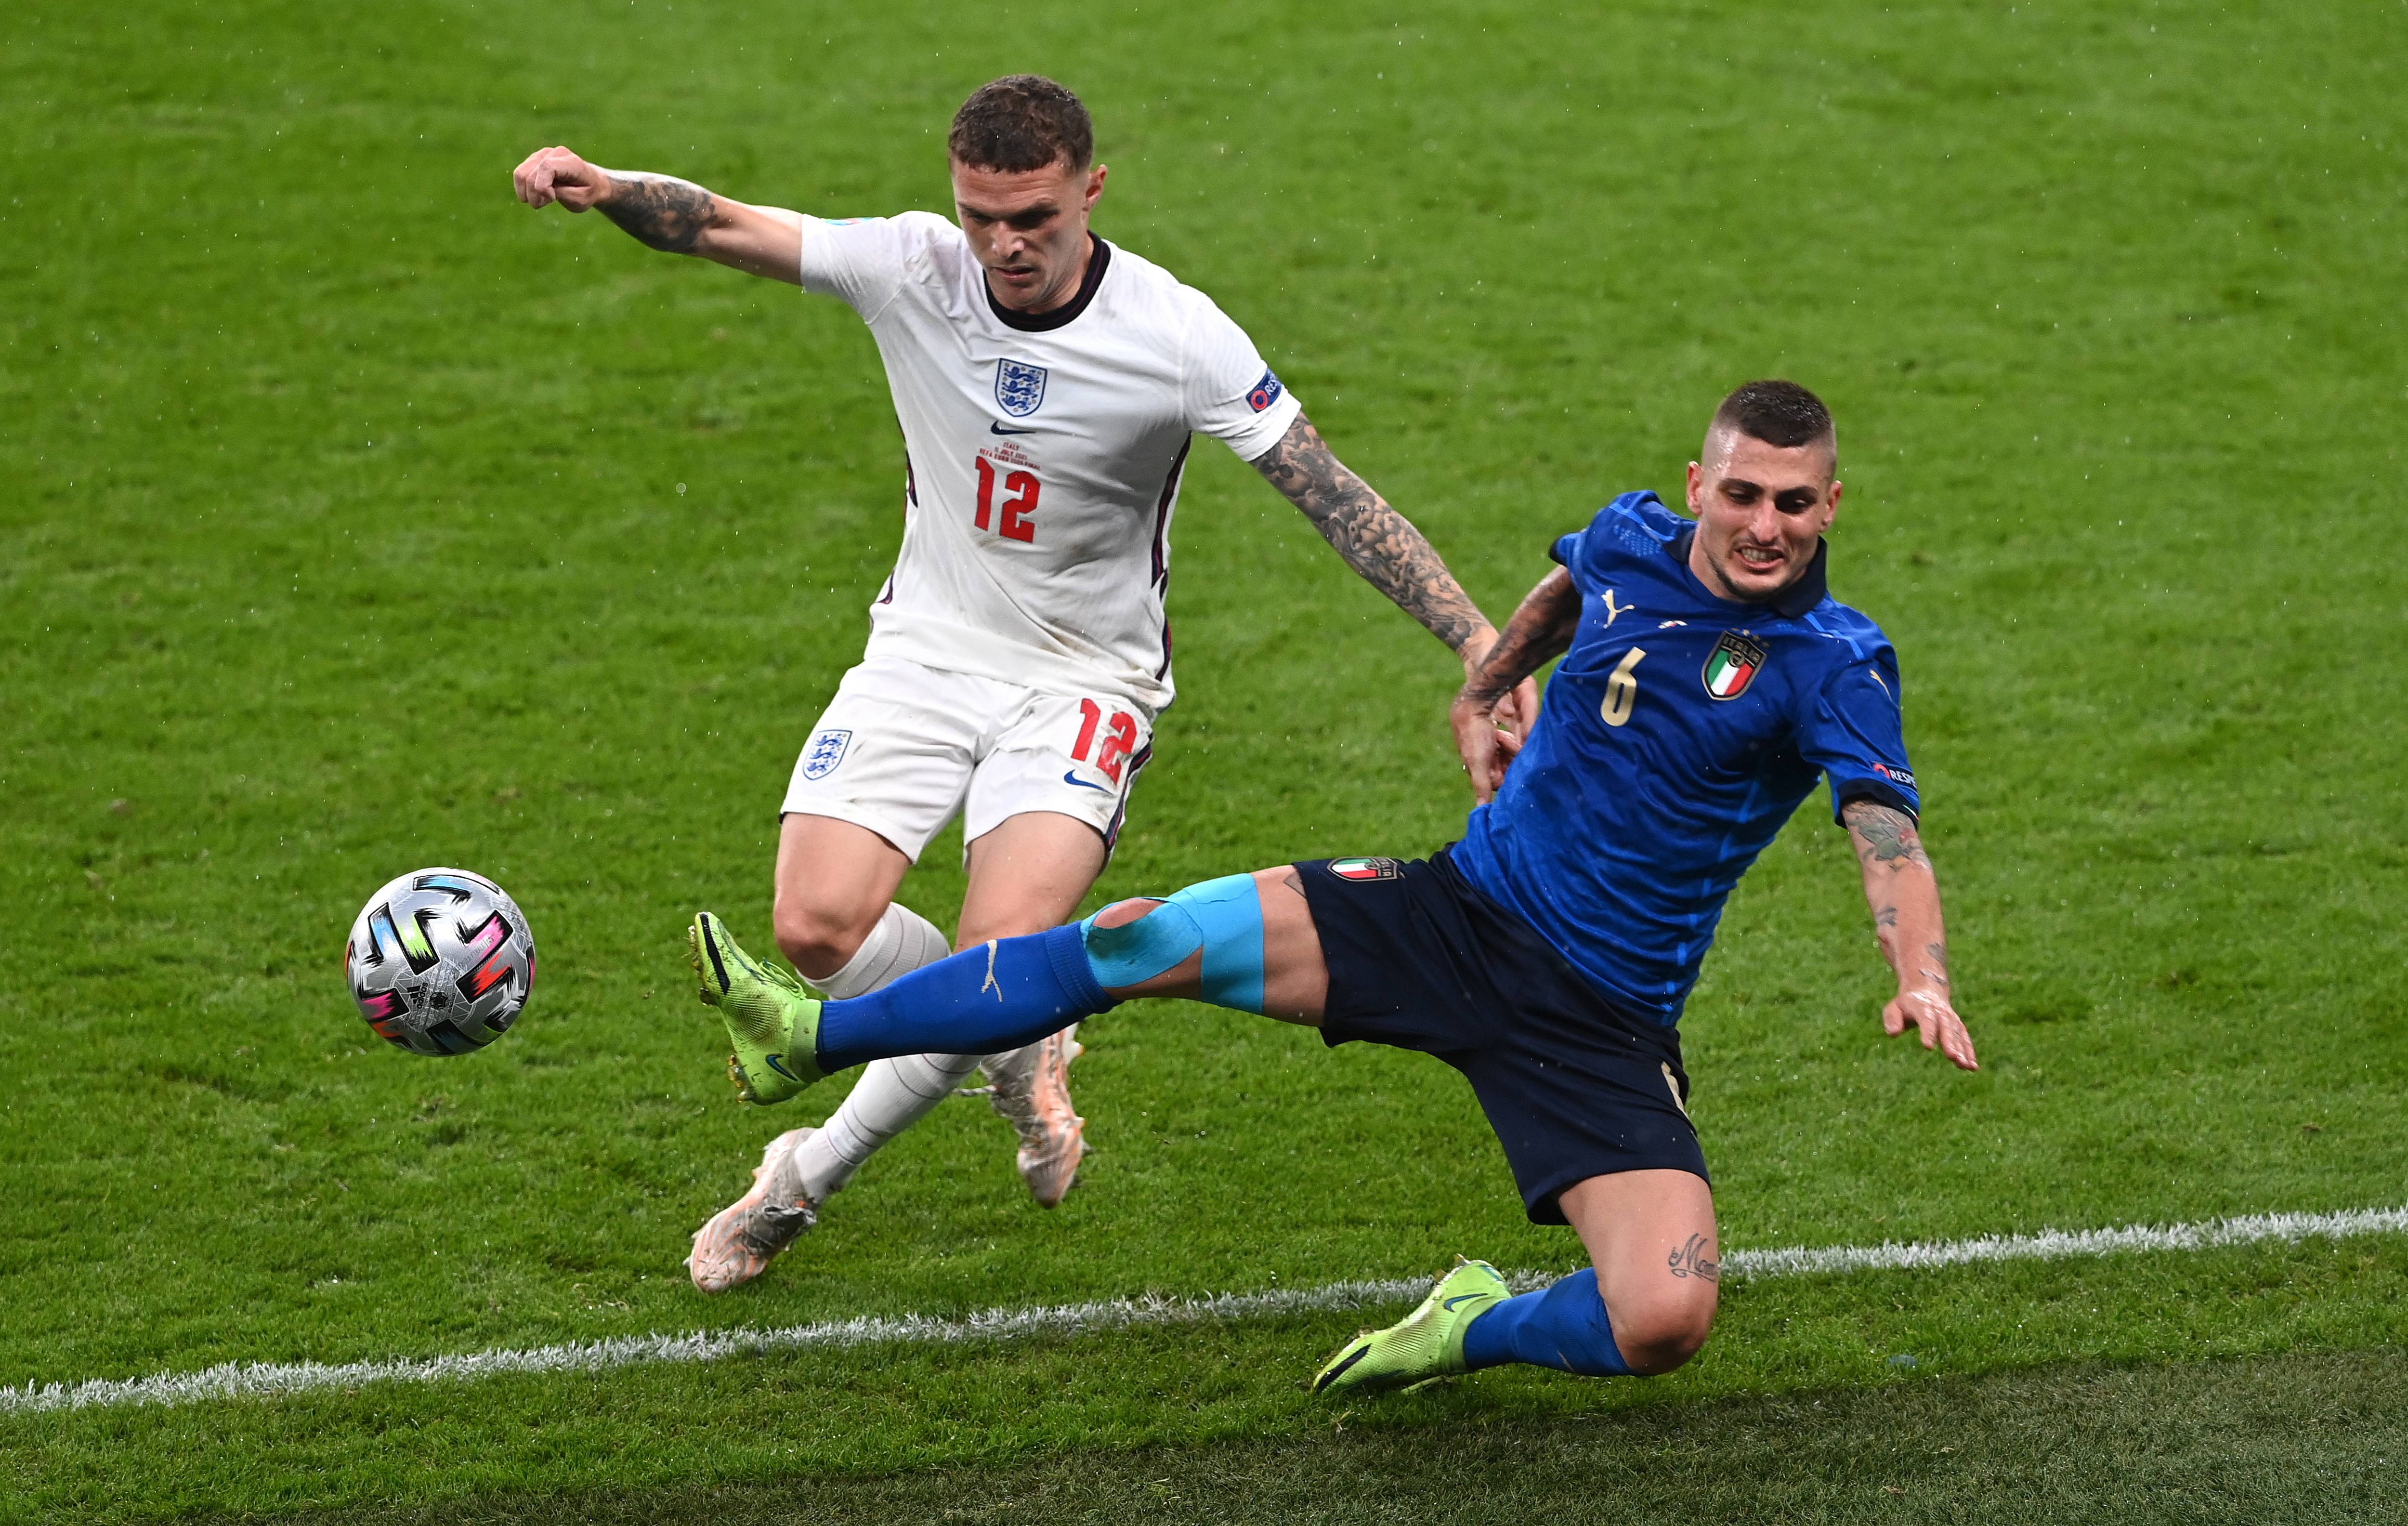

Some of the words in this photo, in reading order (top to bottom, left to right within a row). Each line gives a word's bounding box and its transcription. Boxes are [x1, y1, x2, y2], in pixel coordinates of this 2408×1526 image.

[1003, 442, 1019, 451] ITALY
[974, 456, 1041, 543] 12
[1600, 646, 1647, 726] 6
[1071, 698, 1137, 785] 12
[417, 982, 428, 1009] adidas
